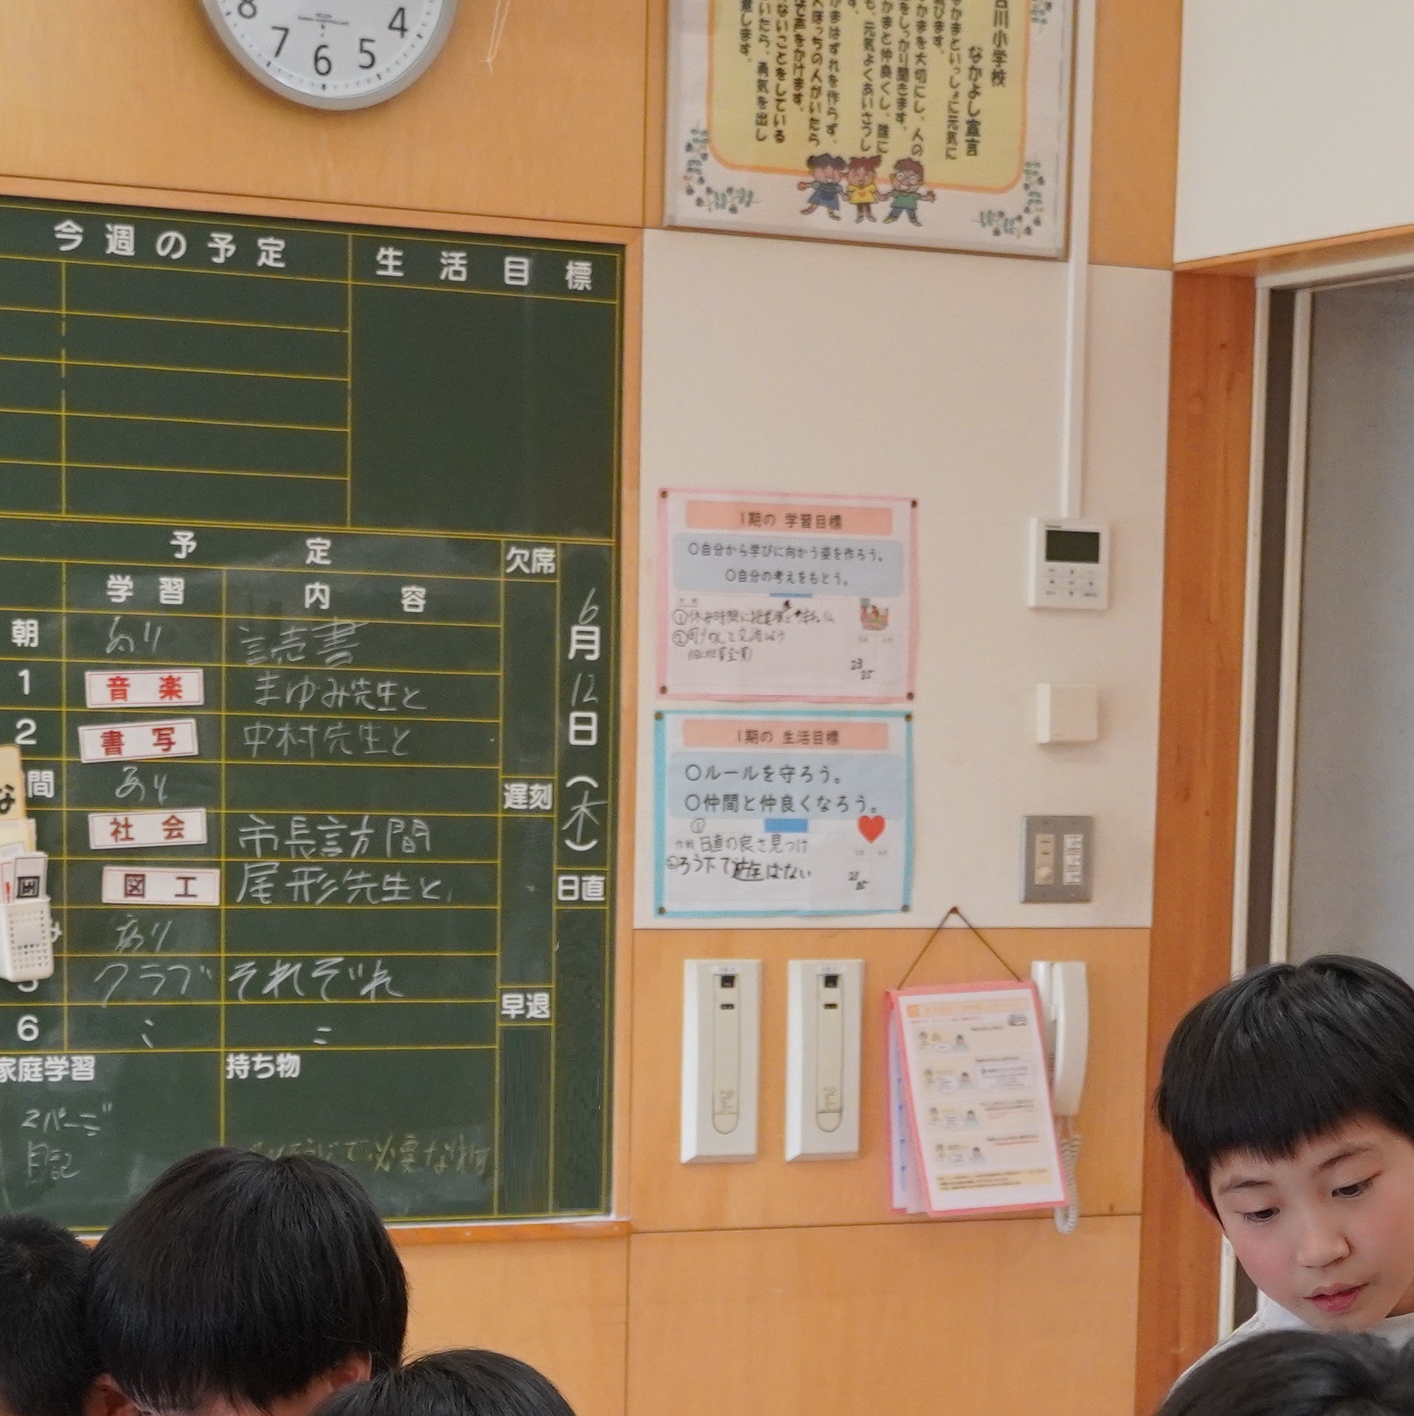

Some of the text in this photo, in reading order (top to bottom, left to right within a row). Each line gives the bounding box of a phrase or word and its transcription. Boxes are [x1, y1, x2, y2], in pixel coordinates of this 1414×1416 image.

[388, 7, 408, 38] 4
[271, 26, 289, 57] 7
[358, 38, 376, 69] 5
[313, 44, 332, 76] 6
[911, 0, 927, 157] かまを大切にし、人の
[946, 0, 962, 160] かまといっしょに元気に
[965, 46, 983, 156] なかよし宣言
[54, 219, 287, 269] 今週の予定
[376, 246, 593, 292] 生活目標
[784, 514, 842, 529] 学習目標
[170, 530, 333, 567] 予定
[505, 547, 557, 574] 欠席
[106, 574, 186, 605] 学習
[304, 582, 427, 614] 内容
[11, 620, 39, 648] 朝
[238, 619, 373, 669] 読書
[19, 671, 31, 695] 1
[106, 675, 183, 702] 音楽
[15, 720, 37, 745] 2
[100, 728, 176, 756] 書写
[783, 730, 840, 745] 生活目標
[28, 770, 54, 799] 間
[503, 783, 553, 810] 遅刻
[109, 814, 186, 843] 社会
[124, 874, 199, 899] 図工
[558, 876, 605, 902] 日直
[501, 993, 550, 1020] 早退
[17, 1017, 39, 1041] 6
[226, 1054, 301, 1079] 持ち物
